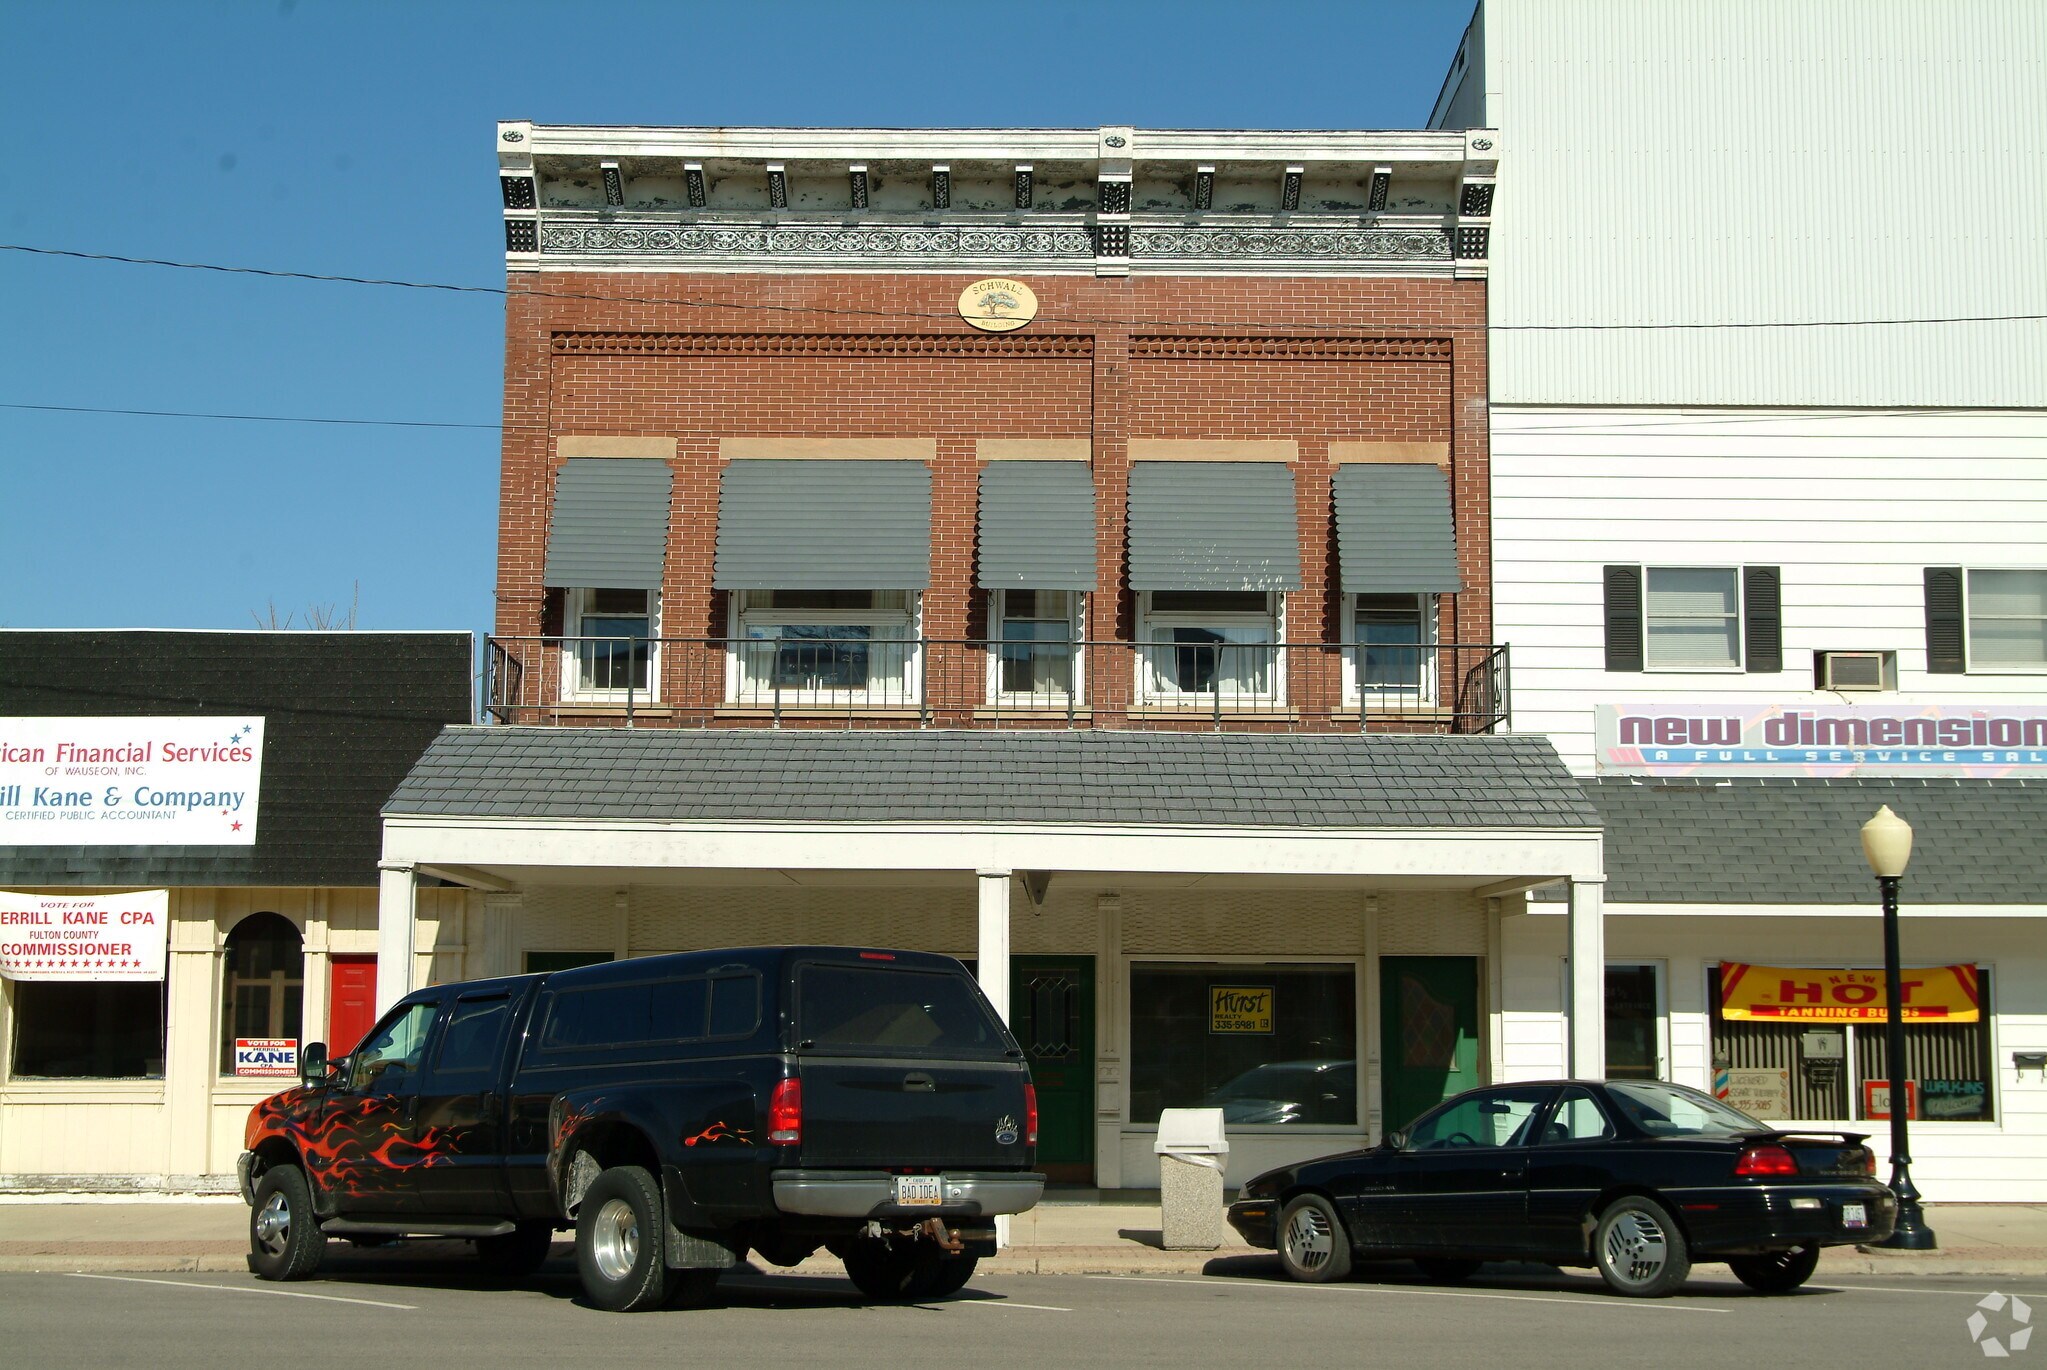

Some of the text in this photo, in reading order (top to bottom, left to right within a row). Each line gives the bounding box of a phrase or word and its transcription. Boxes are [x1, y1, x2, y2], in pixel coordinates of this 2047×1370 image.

[973, 281, 1024, 295] SCHWALL
[1619, 711, 2047, 748] new dimension
[0, 741, 253, 763] ican Financial Services
[1654, 751, 2043, 762] A FULL SERVICE SAL
[45, 766, 147, 777] OF WAUSEON, INC.
[0, 785, 245, 811] ill Kane & Company
[6, 811, 176, 820] CERTIFIED PUBLIC ACCOUNTANT
[1, 911, 154, 925] ERRILL KANE CPA
[29, 930, 99, 940] FULTON COUNTY
[1, 943, 132, 956] COMMISSIONER
[1828, 974, 1876, 985] NEW
[1780, 980, 1924, 1004] HOT
[1215, 990, 1269, 1013] Hurst
[1778, 1006, 1920, 1018] TANNING BUBS
[1215, 1020, 1256, 1029] 335-5981
[239, 1051, 295, 1063] KANE
[1923, 1080, 1985, 1094] WALK-INS
[902, 1185, 939, 1199] BAD IDEA
